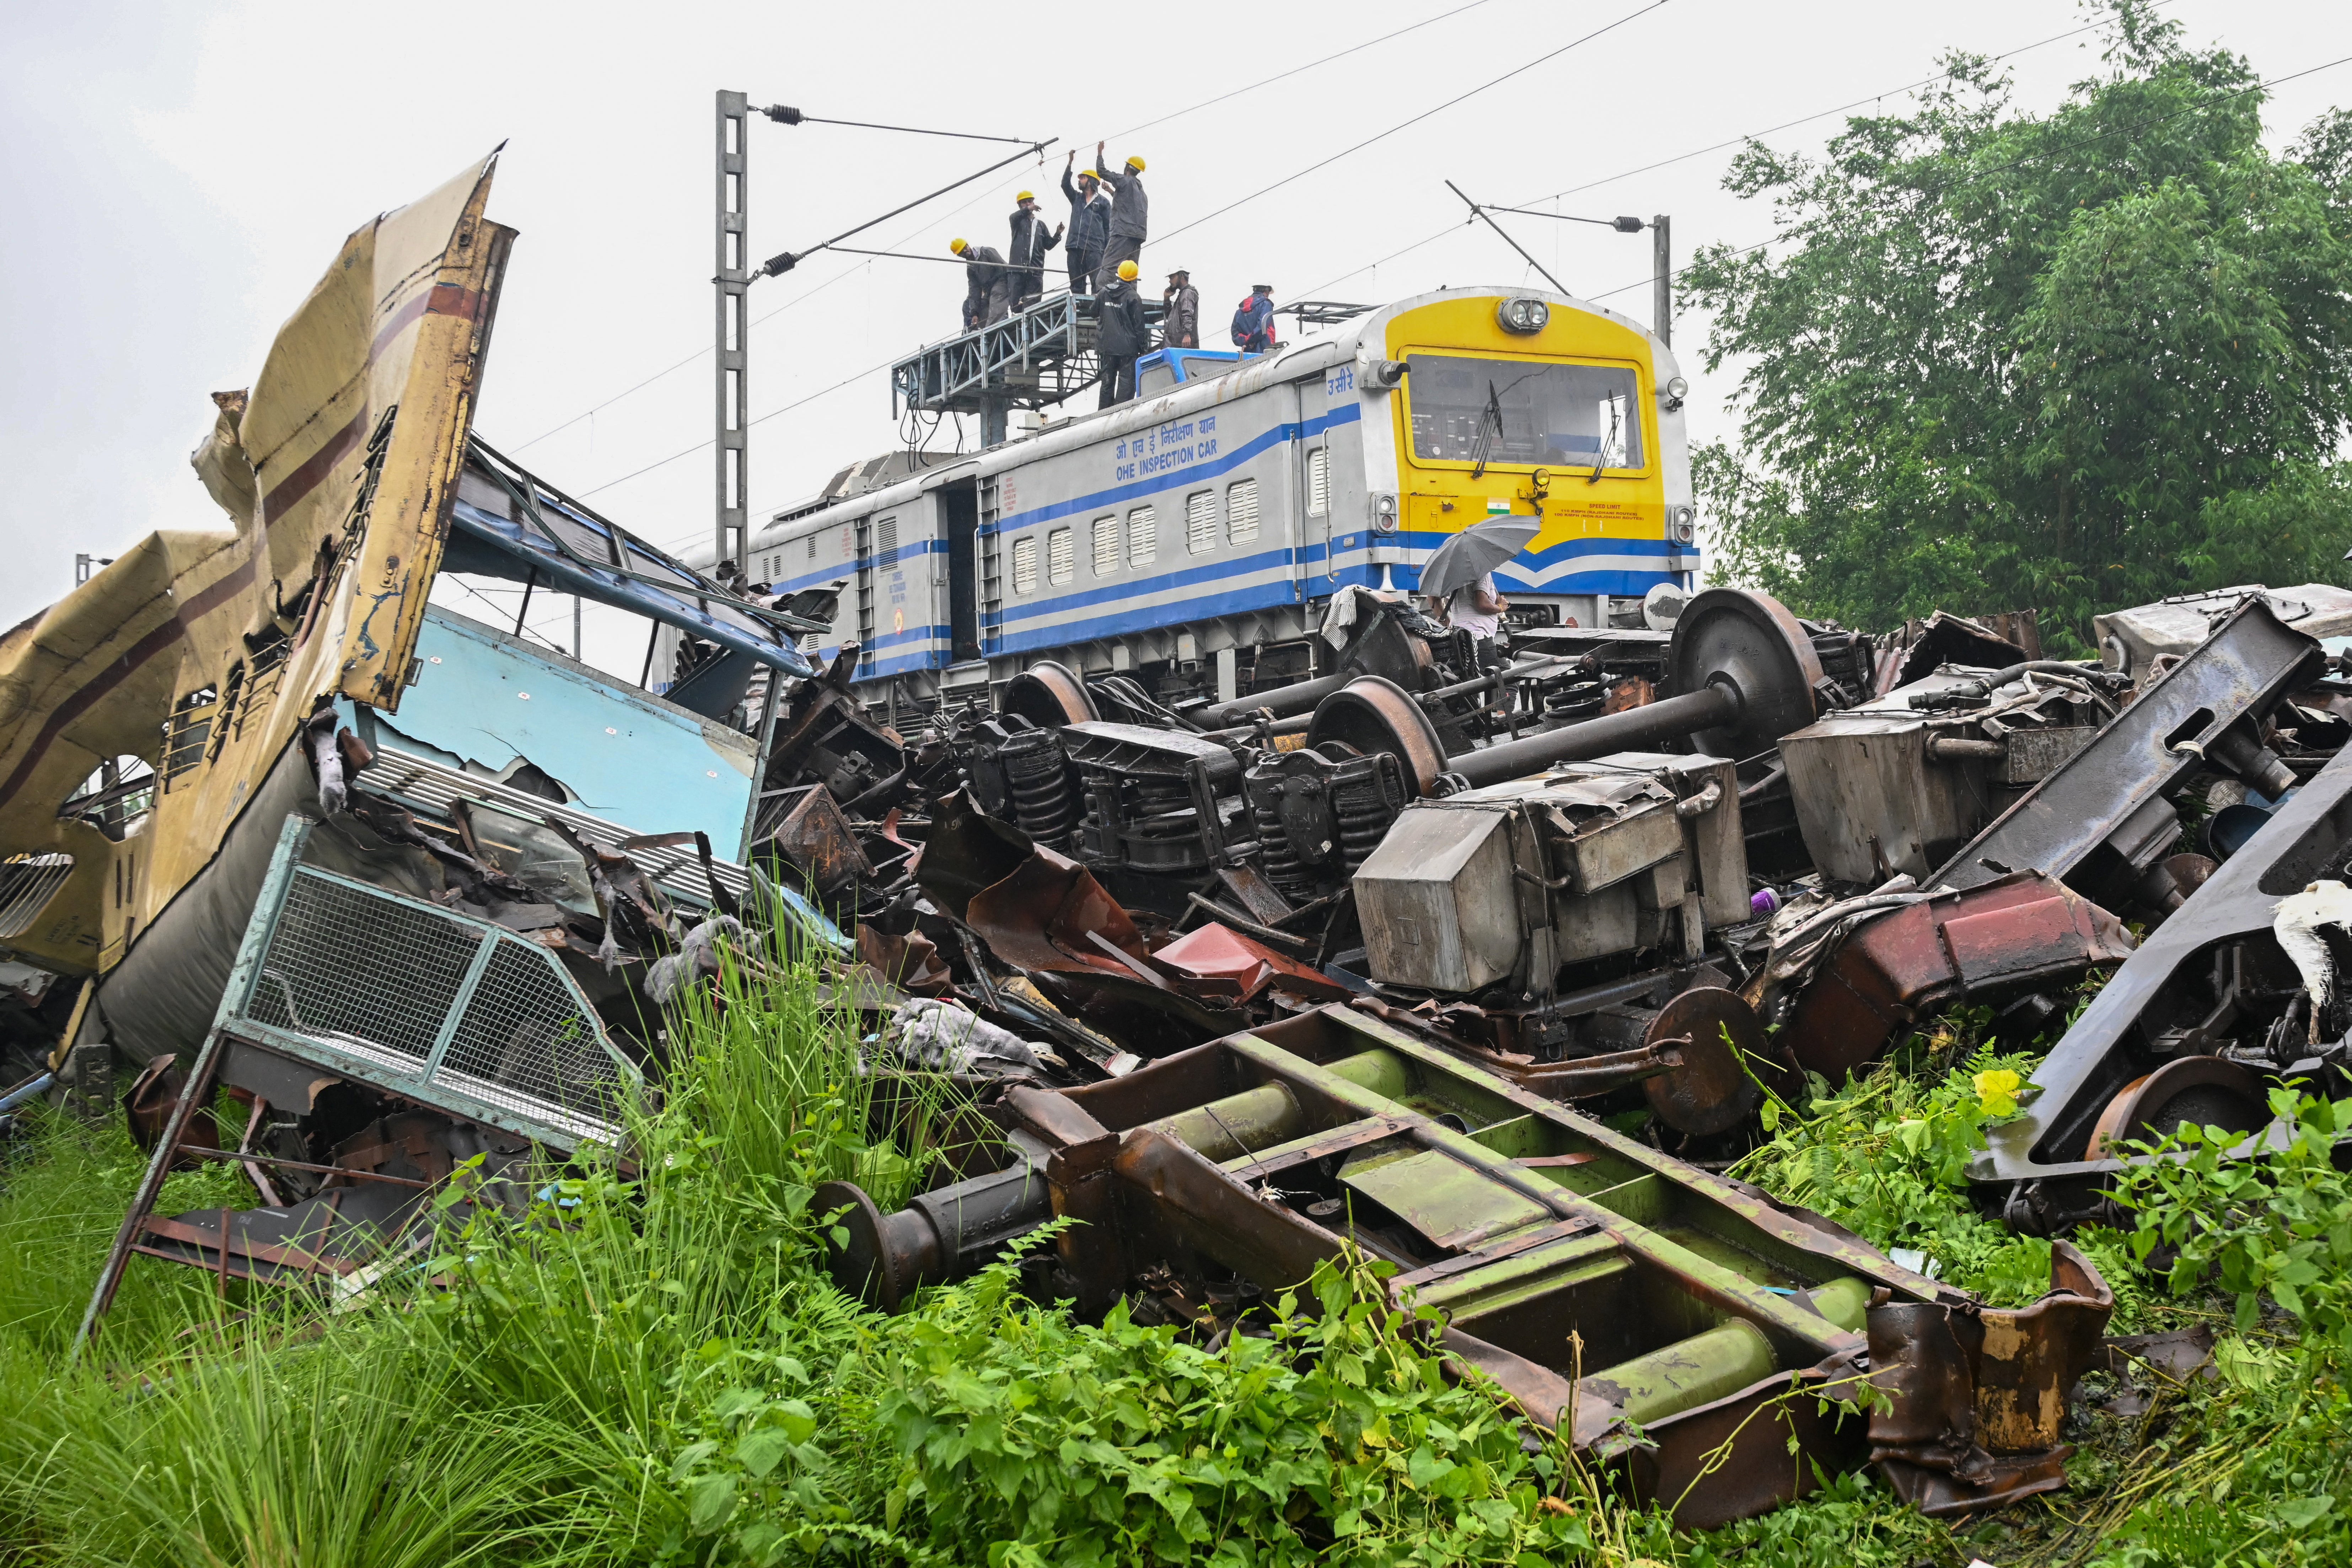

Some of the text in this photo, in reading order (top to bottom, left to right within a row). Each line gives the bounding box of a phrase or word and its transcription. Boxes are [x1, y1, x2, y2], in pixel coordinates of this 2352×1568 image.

[1116, 416, 1215, 460] ओ एच ई निरीक्षण यान
[1117, 439, 1217, 481] OHE INSPECTION CAR
